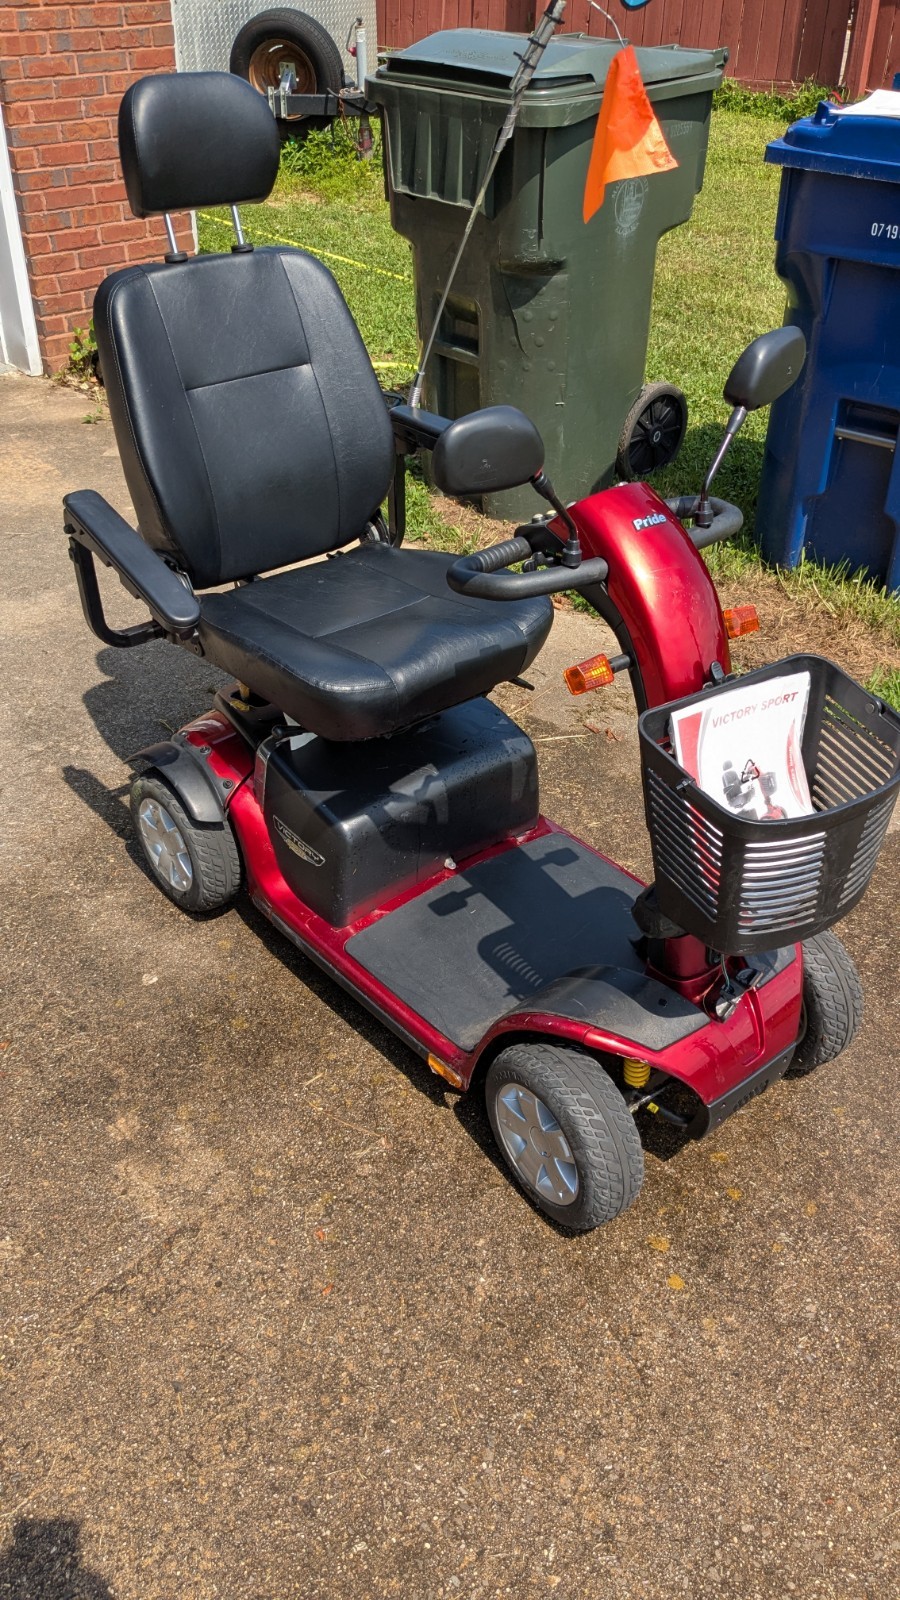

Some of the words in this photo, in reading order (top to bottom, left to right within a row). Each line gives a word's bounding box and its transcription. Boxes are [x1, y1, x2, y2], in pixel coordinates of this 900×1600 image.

[871, 222, 900, 240] 0719
[633, 513, 667, 531] Pride
[712, 704, 758, 728] VICTORY
[761, 691, 799, 711] SPORT
[277, 821, 320, 861] VICTORY
